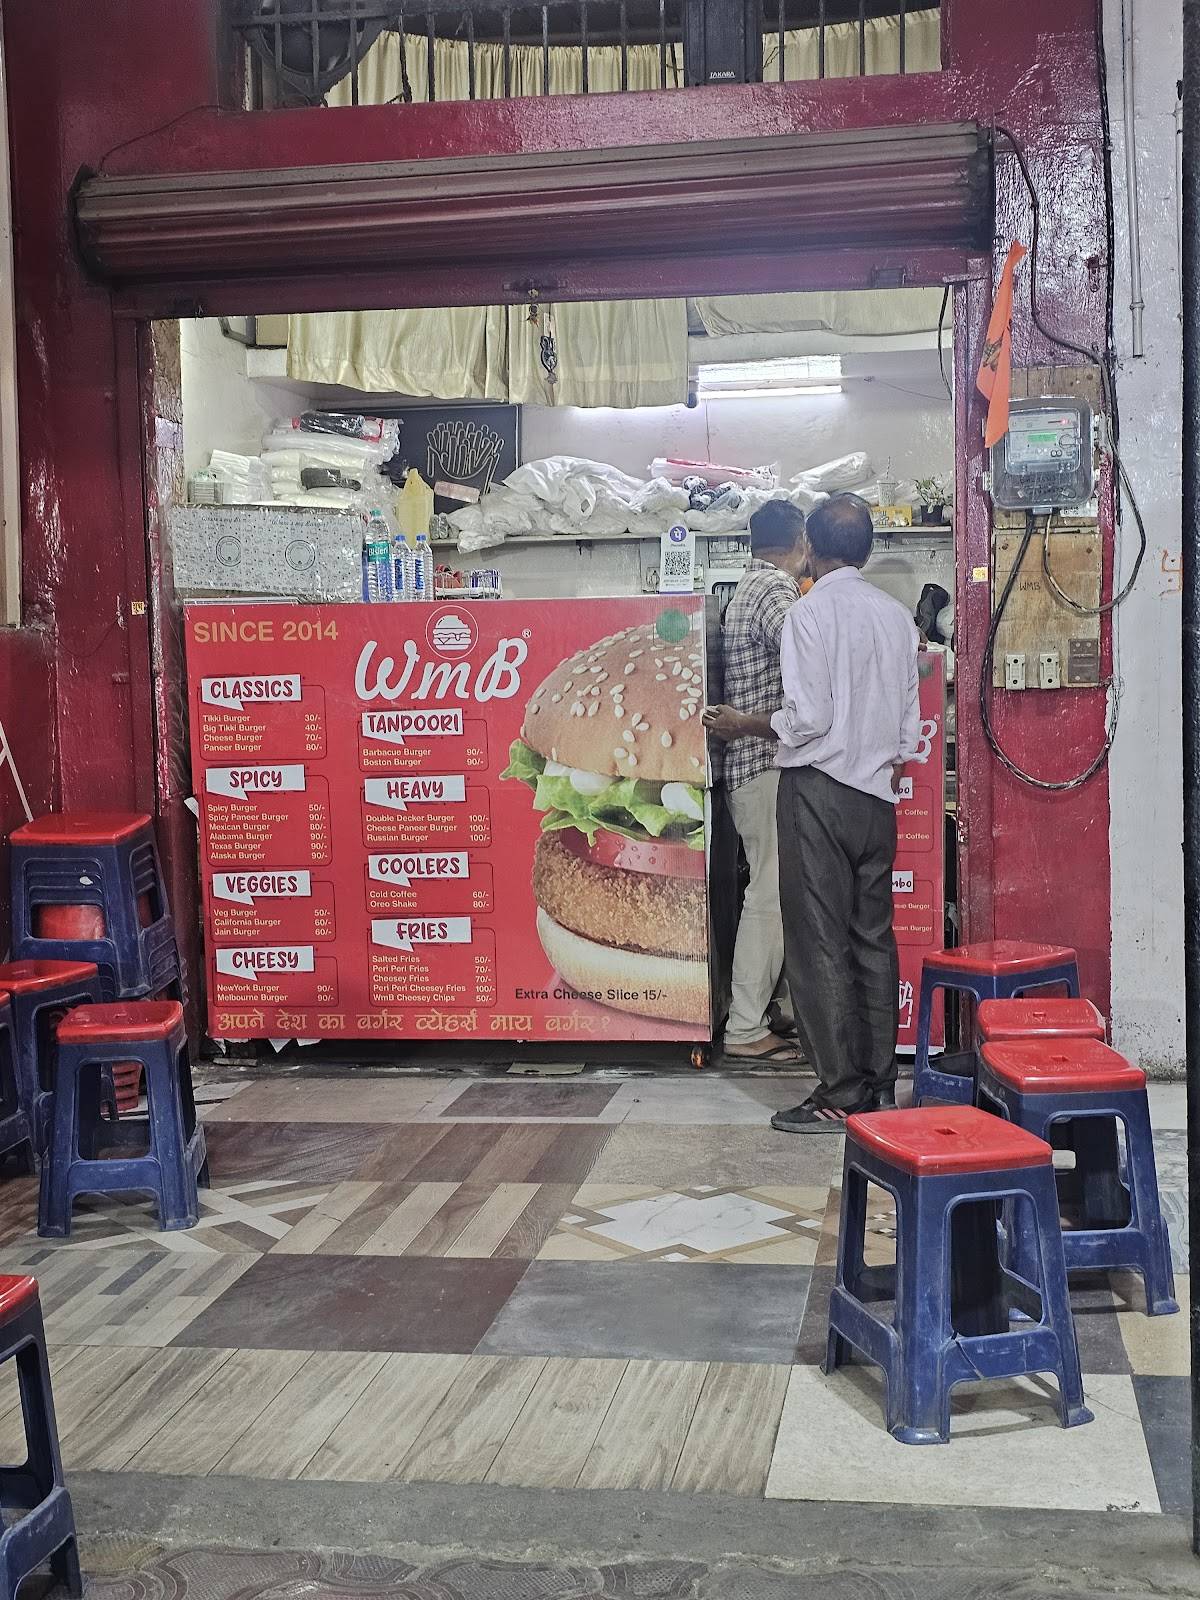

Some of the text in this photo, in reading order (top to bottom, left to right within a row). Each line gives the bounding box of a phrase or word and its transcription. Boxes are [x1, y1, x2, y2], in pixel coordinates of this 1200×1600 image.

[1019, 582, 1041, 591] WMB
[194, 620, 339, 643] SINCE 2014
[210, 680, 293, 699] CLASSICS
[223, 714, 251, 723] Burger
[367, 714, 459, 733] TANDOORI
[203, 724, 217, 733] Big
[239, 724, 267, 732] Burger
[235, 733, 263, 743] Burger
[305, 733, 322, 741] 70/-
[235, 743, 262, 752] Burger
[305, 743, 323, 751] 80/-
[363, 748, 484, 757] Barbacue Burger 90/-
[363, 758, 484, 768] Boston Burger 90/-
[229, 770, 283, 789] SPICY
[387, 780, 444, 800] HEAVY
[207, 803, 325, 813] Spicy Burger 50/-
[208, 813, 326, 822] Spicy Paneer Burger 90/-
[366, 814, 489, 823] Double Decker Burger 100/-
[209, 822, 327, 832] Mexican Burger 80/-
[366, 824, 490, 833] Cheese Paneer Burger 100/-
[209, 832, 327, 841] Alabama Burger 90/-
[367, 833, 490, 843] Russian Burger 100/-
[234, 842, 261, 851] Burger
[310, 842, 328, 850] 90/-
[210, 851, 328, 860] Alaska Burger 90/-
[378, 857, 460, 876] COOLERS
[225, 875, 298, 894] VEGGIES
[369, 890, 489, 898] Cold Coffee 60/-
[370, 900, 490, 908] Oreo Shake 80/-
[213, 909, 331, 918] Veg Burger 50/-
[214, 918, 331, 927] California Burger 60/-
[214, 928, 332, 937] Jain Burger 60/-
[396, 921, 448, 941] FRIES
[910, 925, 933, 933] Burger
[232, 951, 299, 970] CHEESY
[372, 955, 398, 963] Salted
[474, 956, 491, 964] 50/-
[409, 965, 429, 973] Fries
[373, 975, 408, 983] Cheesey
[475, 975, 491, 983] 70/-
[217, 984, 334, 993] NewYork Burger 90/-
[373, 984, 496, 994] Peri Peri Cheesey Fries 100/-
[217, 994, 334, 1003] Melbourne Burger 90/-
[373, 994, 395, 1002] WmB
[396, 993, 431, 1003] Cheesey
[433, 994, 455, 1003] Chips
[515, 988, 668, 1000] Extra Cheese Slice 15/-
[216, 1009, 265, 1031] अपने
[275, 1009, 307, 1031] देश
[317, 1014, 346, 1030] का
[489, 1015, 533, 1032] माय
